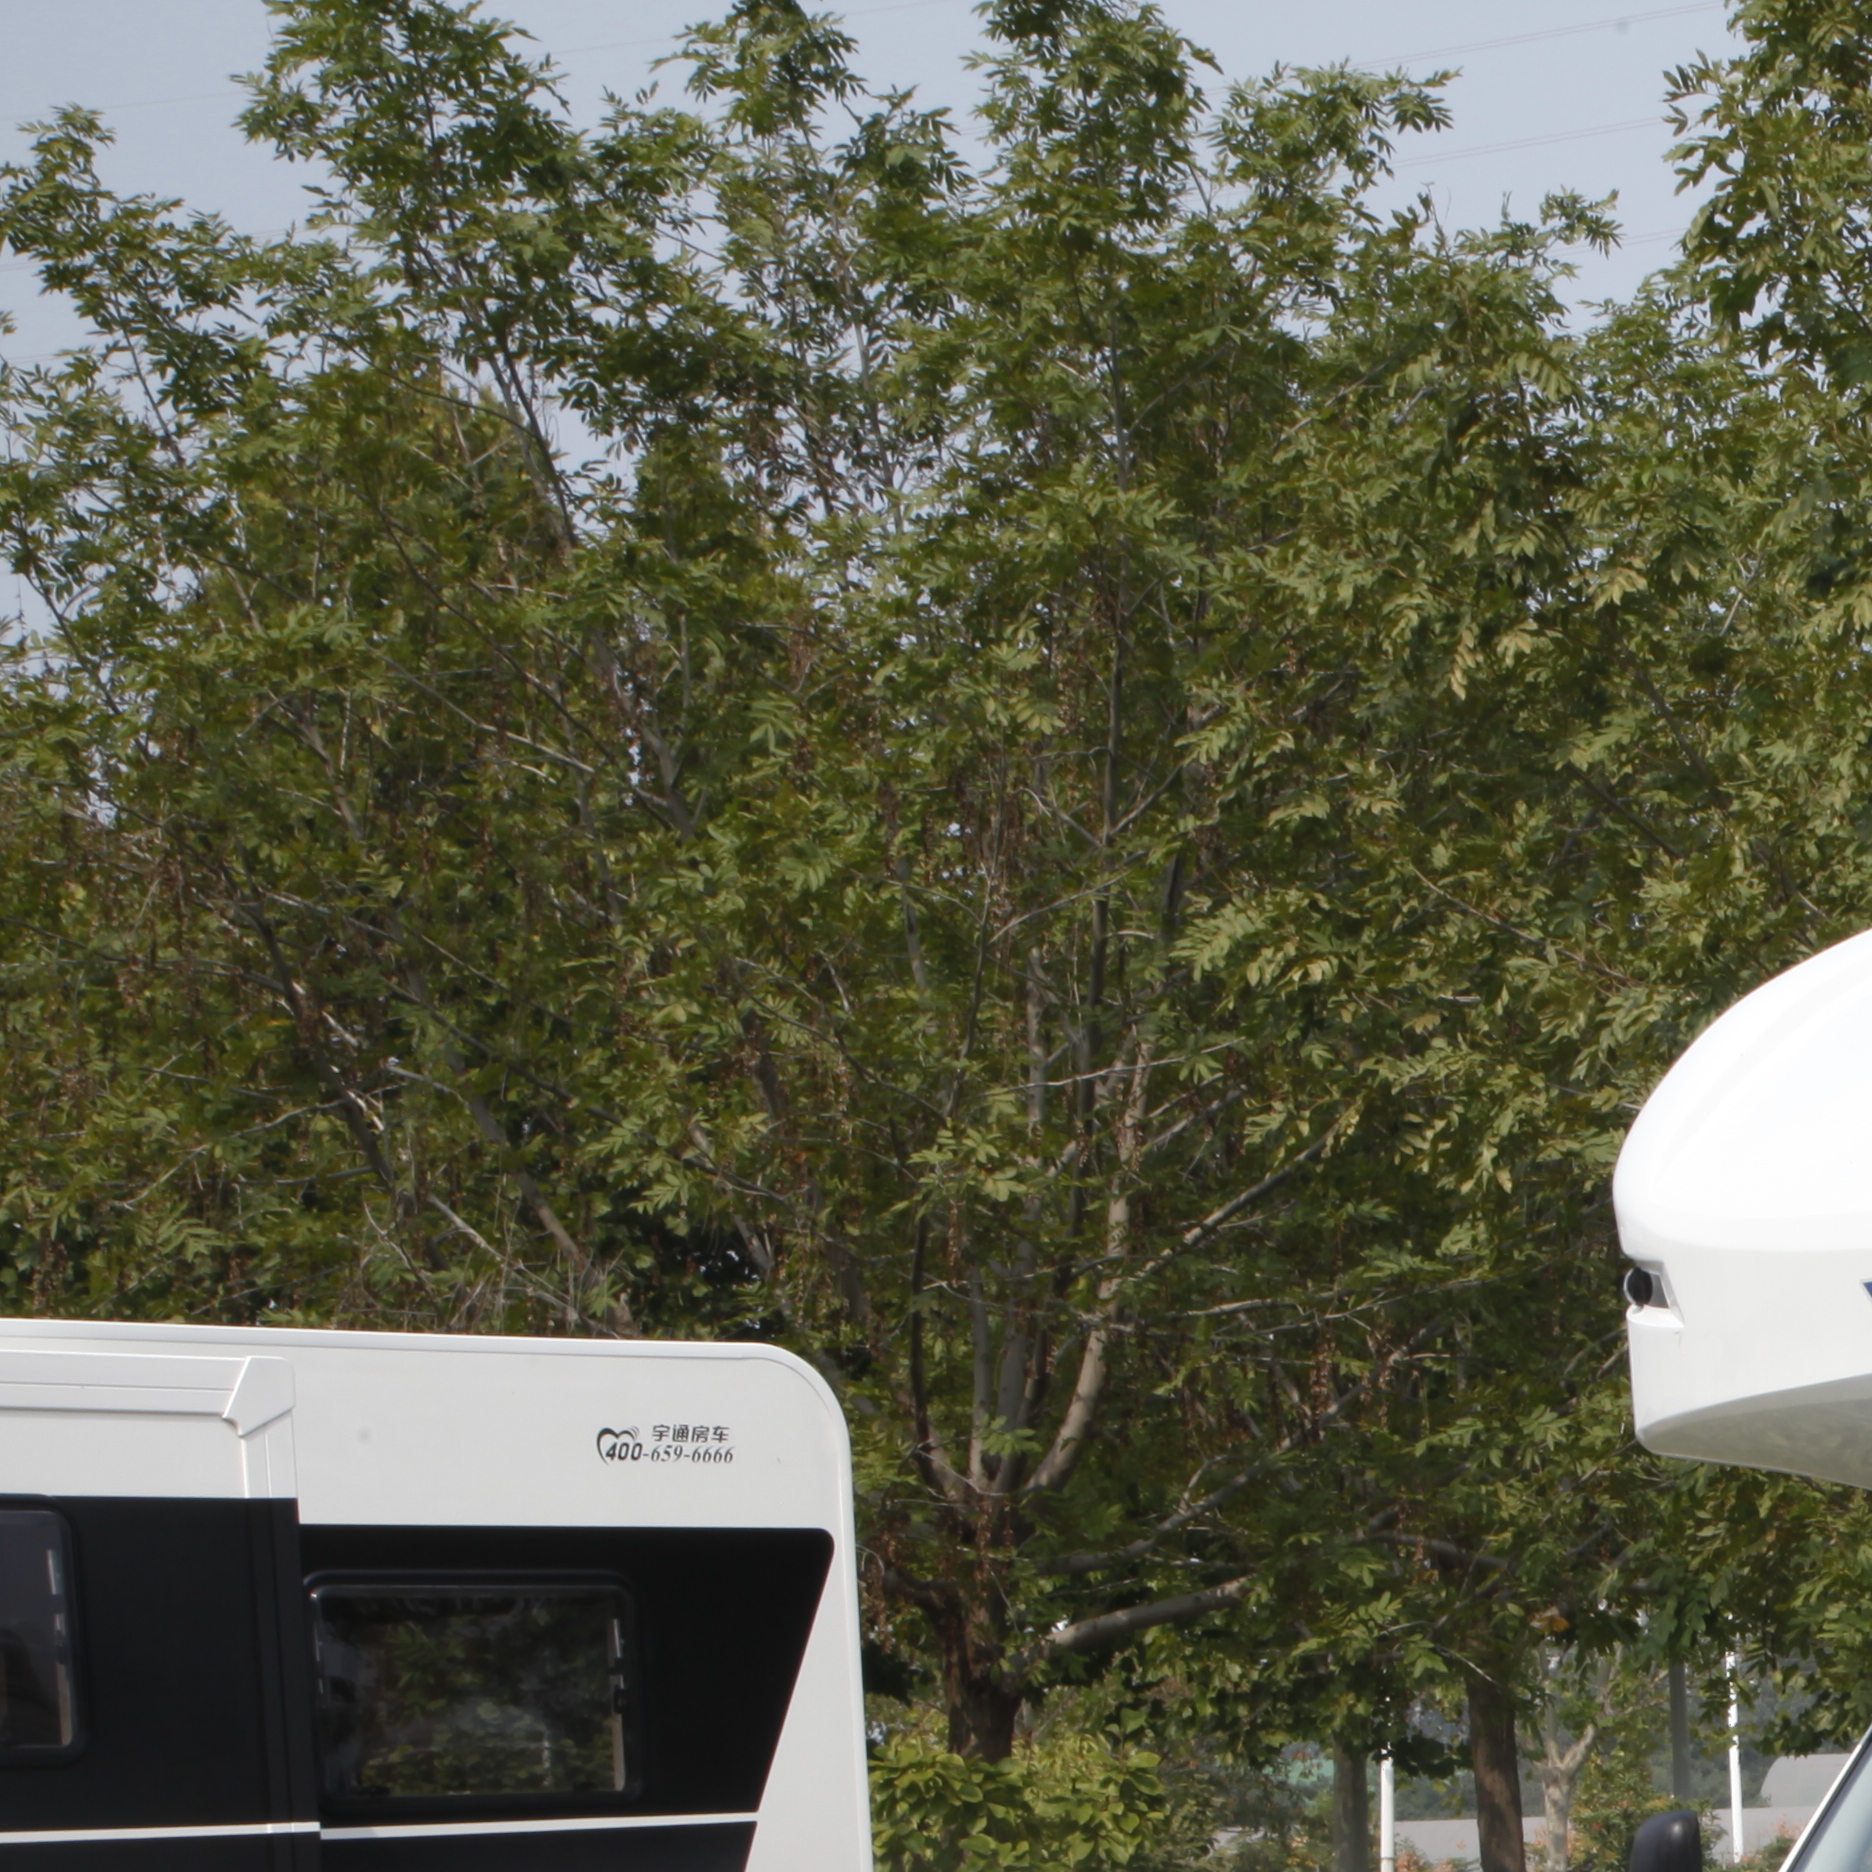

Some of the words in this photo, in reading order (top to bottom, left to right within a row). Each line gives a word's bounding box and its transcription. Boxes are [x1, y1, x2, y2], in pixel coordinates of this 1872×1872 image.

[652, 1424, 730, 1443] 宇通房车
[605, 1442, 736, 1464] 400-659-6666
